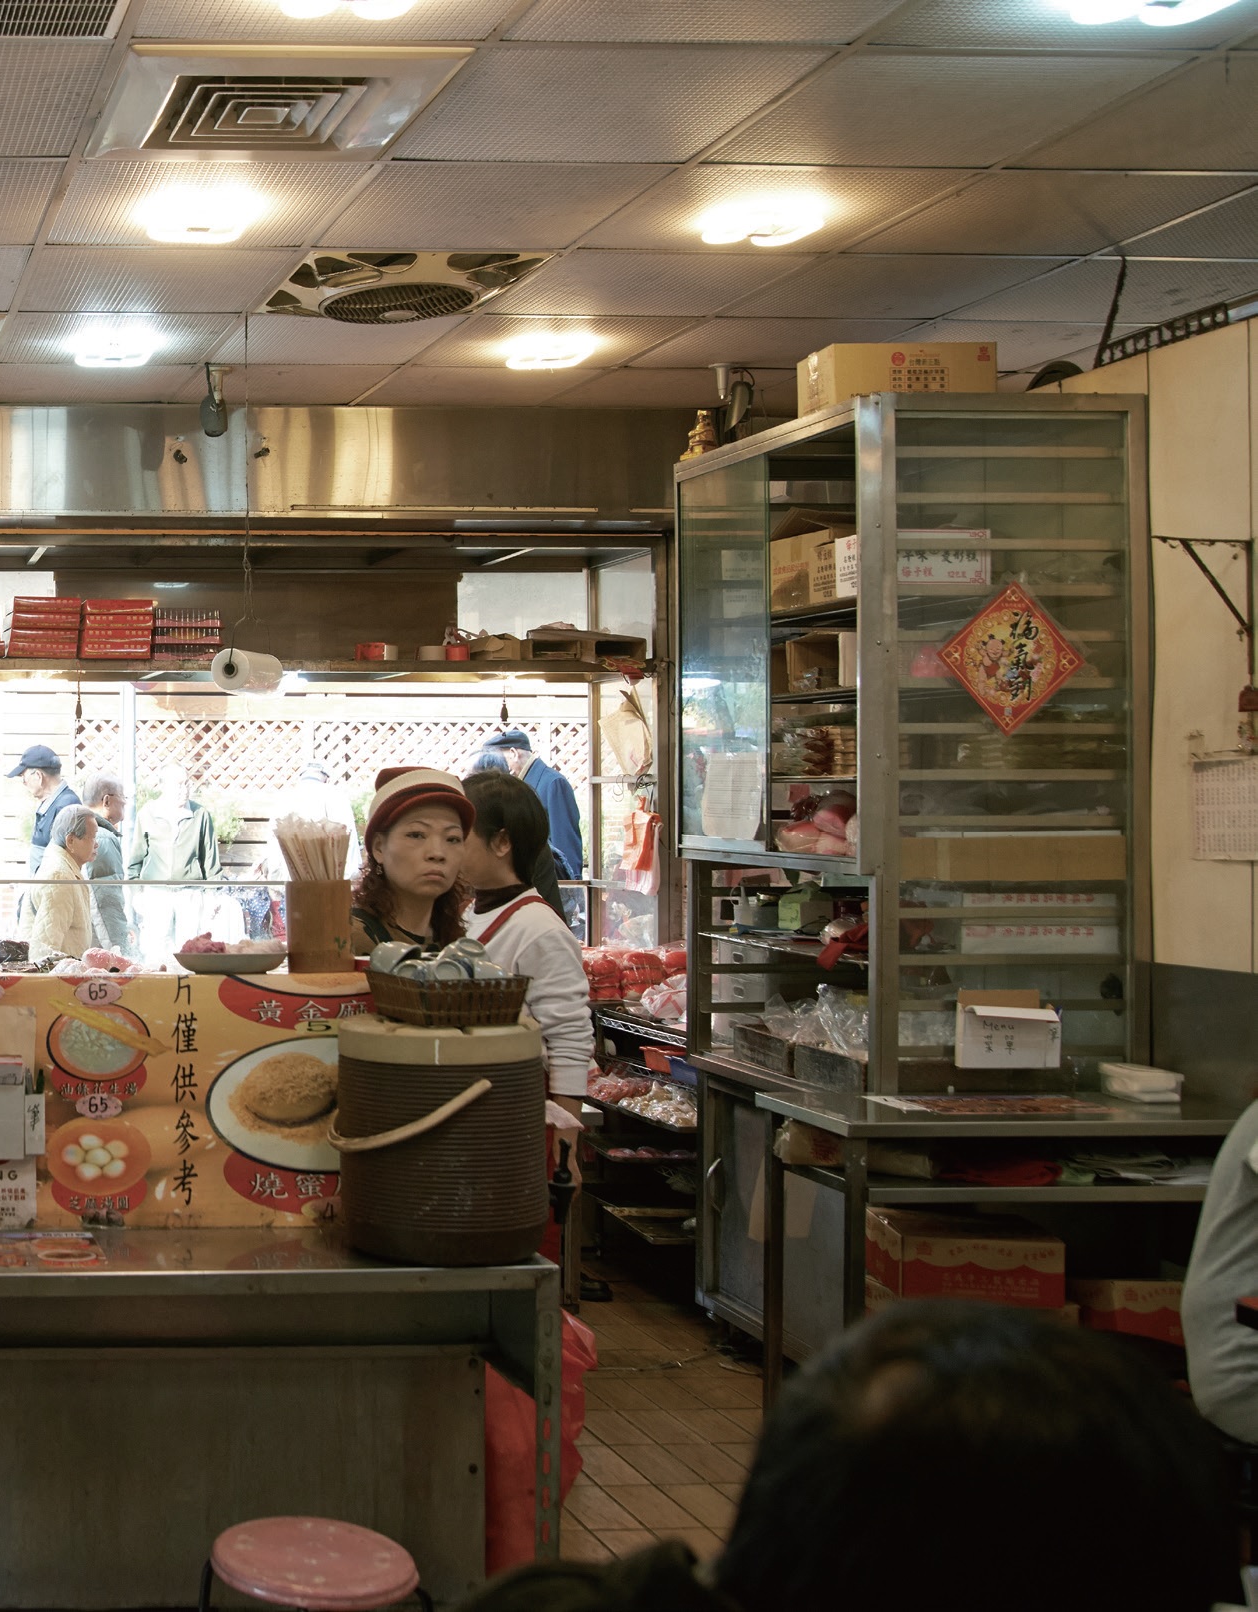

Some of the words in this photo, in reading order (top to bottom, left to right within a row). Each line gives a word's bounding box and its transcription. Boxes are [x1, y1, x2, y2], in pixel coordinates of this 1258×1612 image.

[88, 983, 108, 999] 65
[983, 1020, 1015, 1031] Menu
[60, 1081, 138, 1096] 油條花生湯
[88, 1096, 108, 1113] 65
[250, 1173, 341, 1199] 燒蜜
[69, 1196, 130, 1210] 芝麻湯圓
